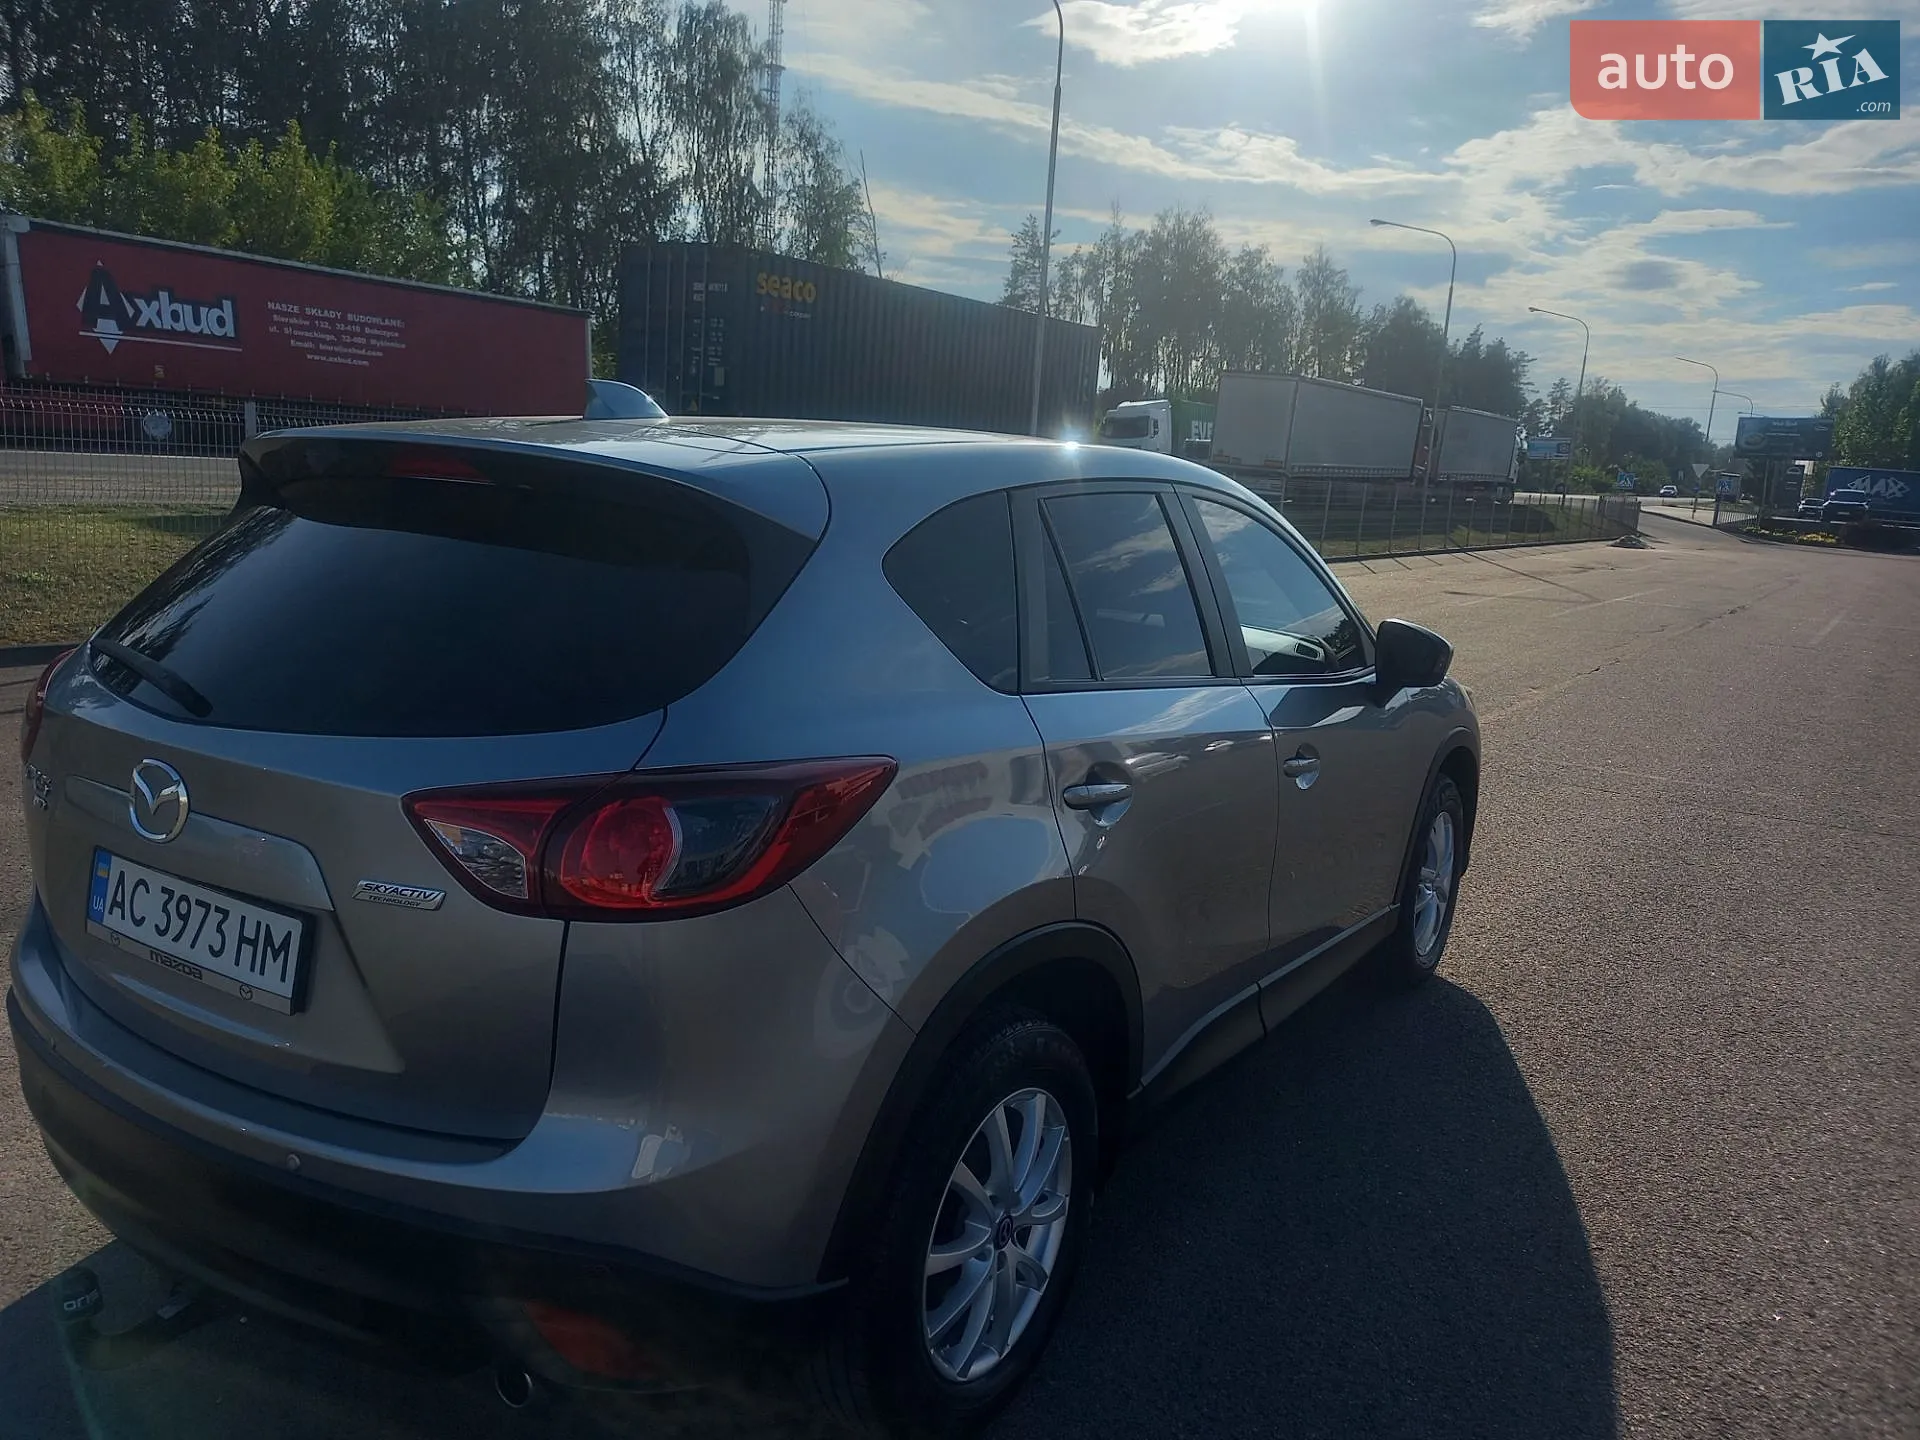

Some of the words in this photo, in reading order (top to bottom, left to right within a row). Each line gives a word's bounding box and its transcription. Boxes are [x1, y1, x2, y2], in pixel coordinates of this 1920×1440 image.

[756, 272, 817, 303] seaco
[82, 267, 236, 337] Axbud
[267, 301, 300, 314] NASZE
[362, 882, 436, 900] SKYACTIV
[92, 895, 105, 913] UA
[107, 869, 151, 928] AC
[153, 885, 230, 959] 3973
[233, 914, 293, 984] HM
